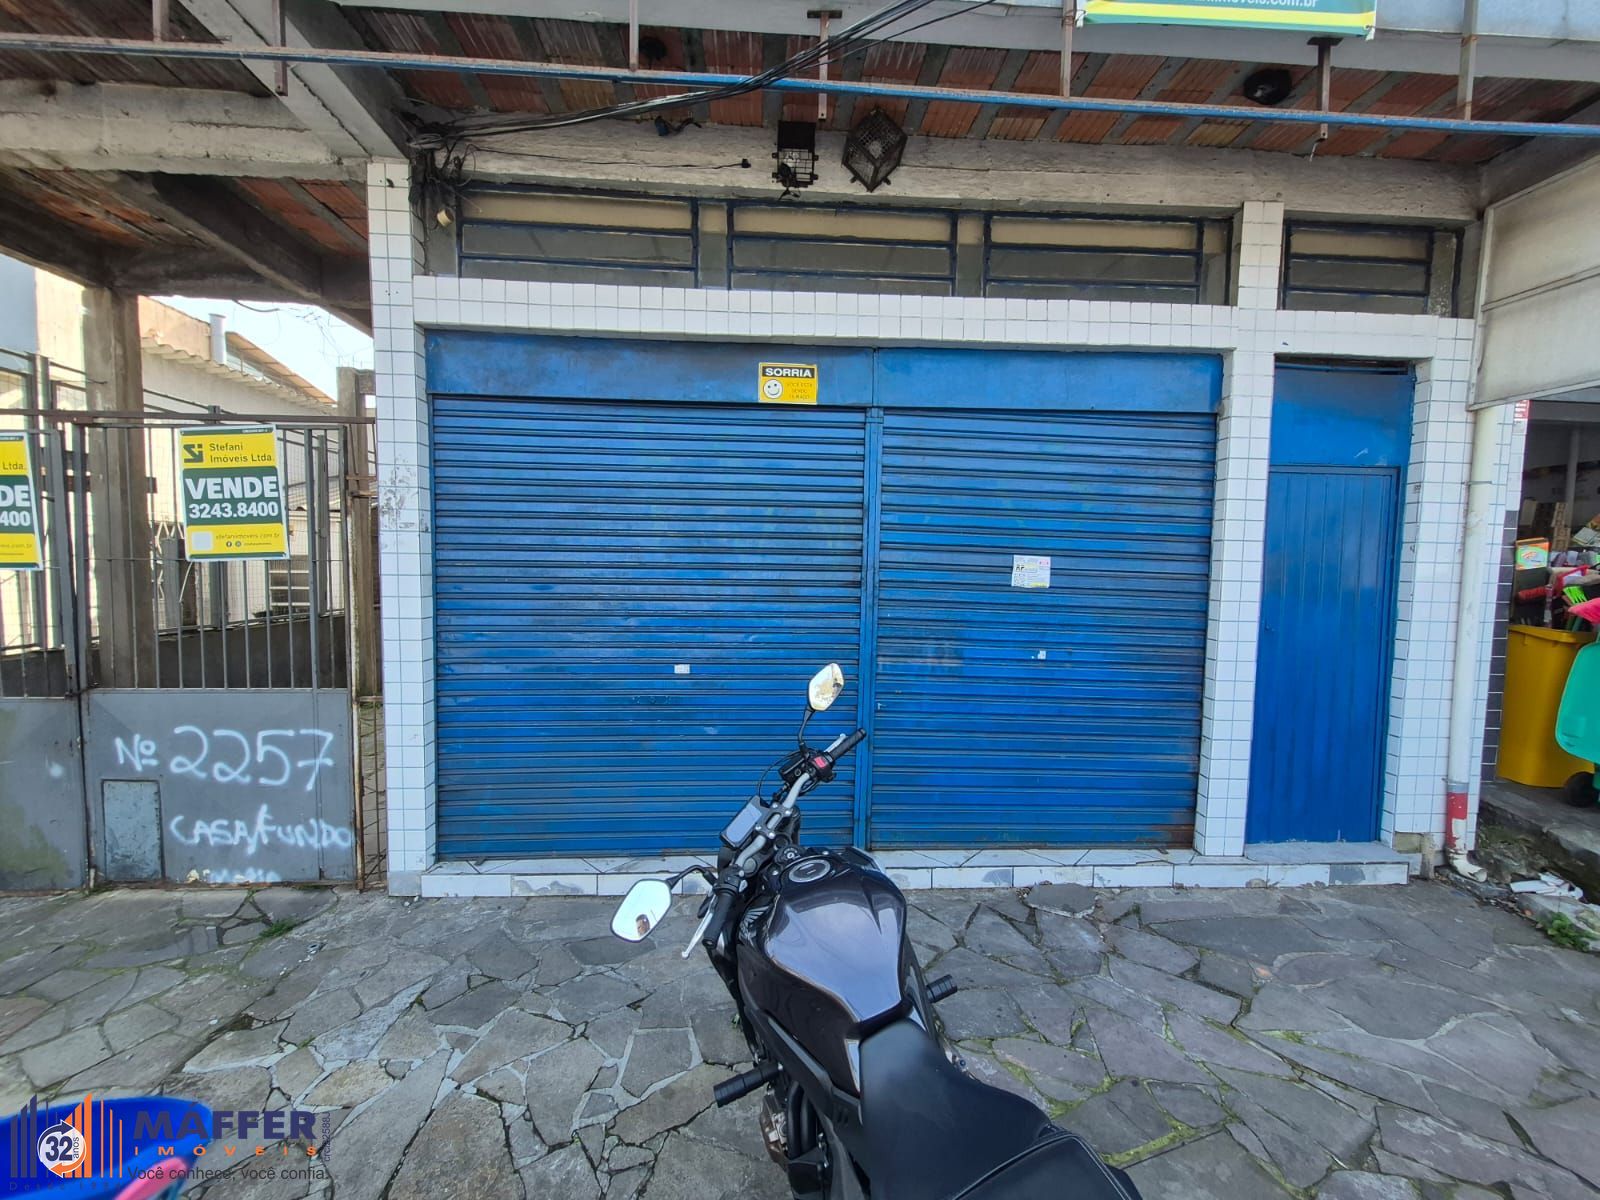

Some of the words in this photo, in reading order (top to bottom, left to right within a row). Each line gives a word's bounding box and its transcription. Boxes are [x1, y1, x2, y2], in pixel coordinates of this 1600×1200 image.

[765, 367, 812, 378] SORRIA
[209, 442, 244, 452] Stefani
[185, 476, 279, 500] VENDE
[188, 501, 279, 519] 3243.8400
[169, 725, 334, 791] 2257
